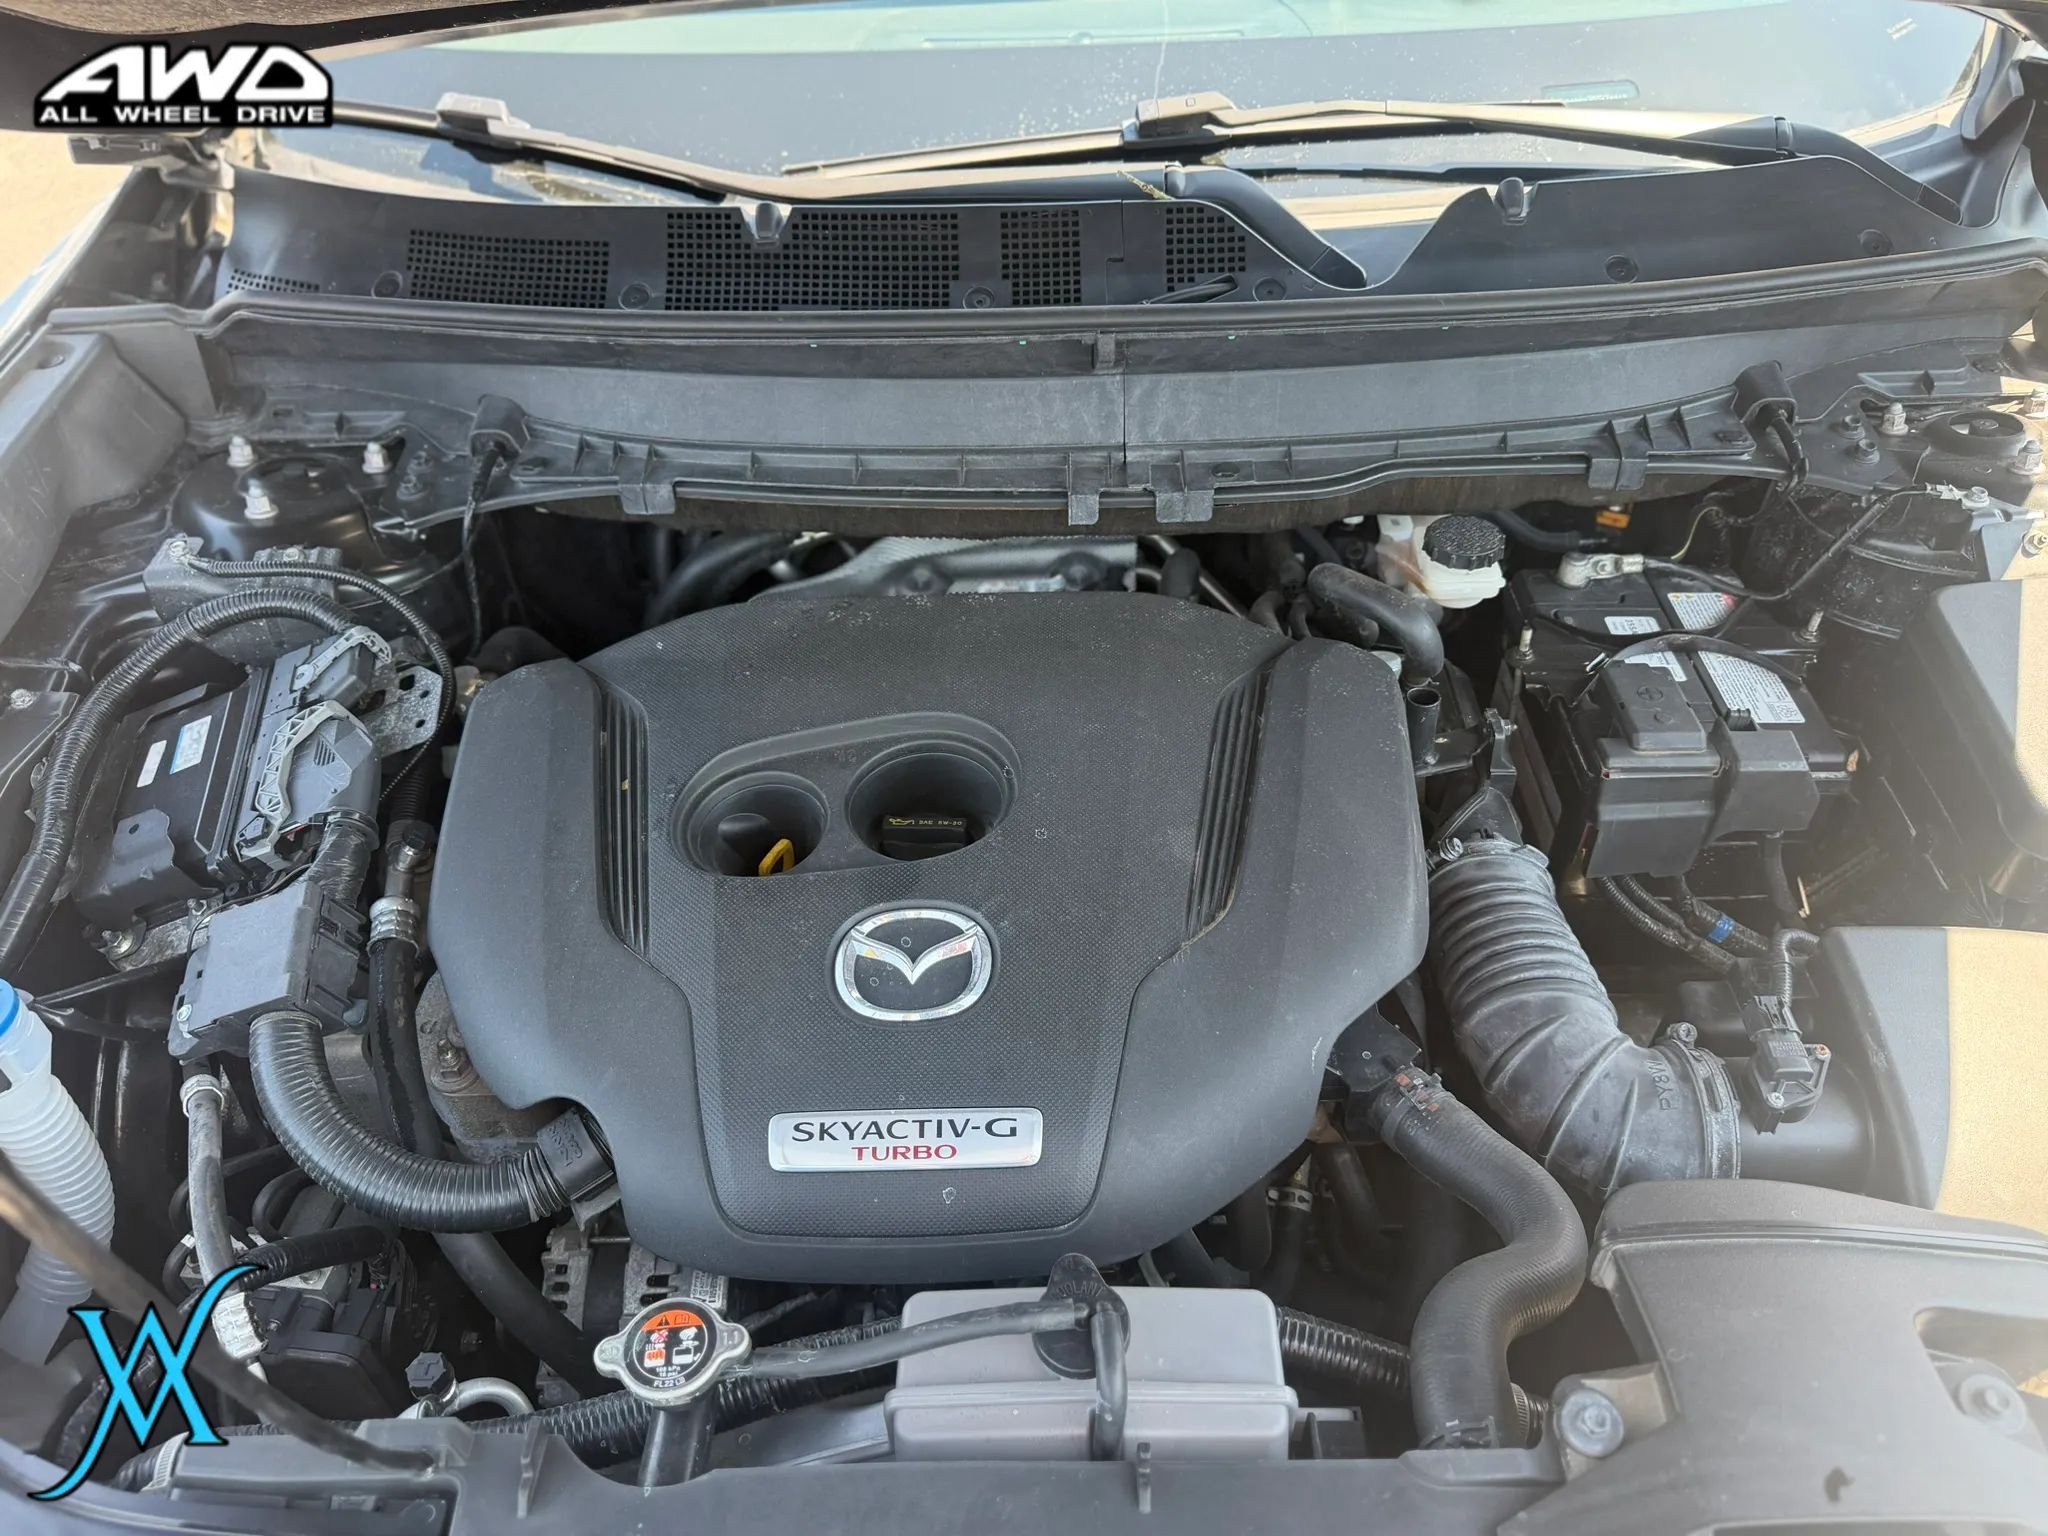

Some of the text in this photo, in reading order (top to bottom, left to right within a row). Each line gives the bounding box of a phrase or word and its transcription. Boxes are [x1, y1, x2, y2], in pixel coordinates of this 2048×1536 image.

[791, 1117, 1018, 1142] SKYACTIV-G
[851, 1143, 958, 1162] TURBO
[653, 1379, 675, 1388] FL22
